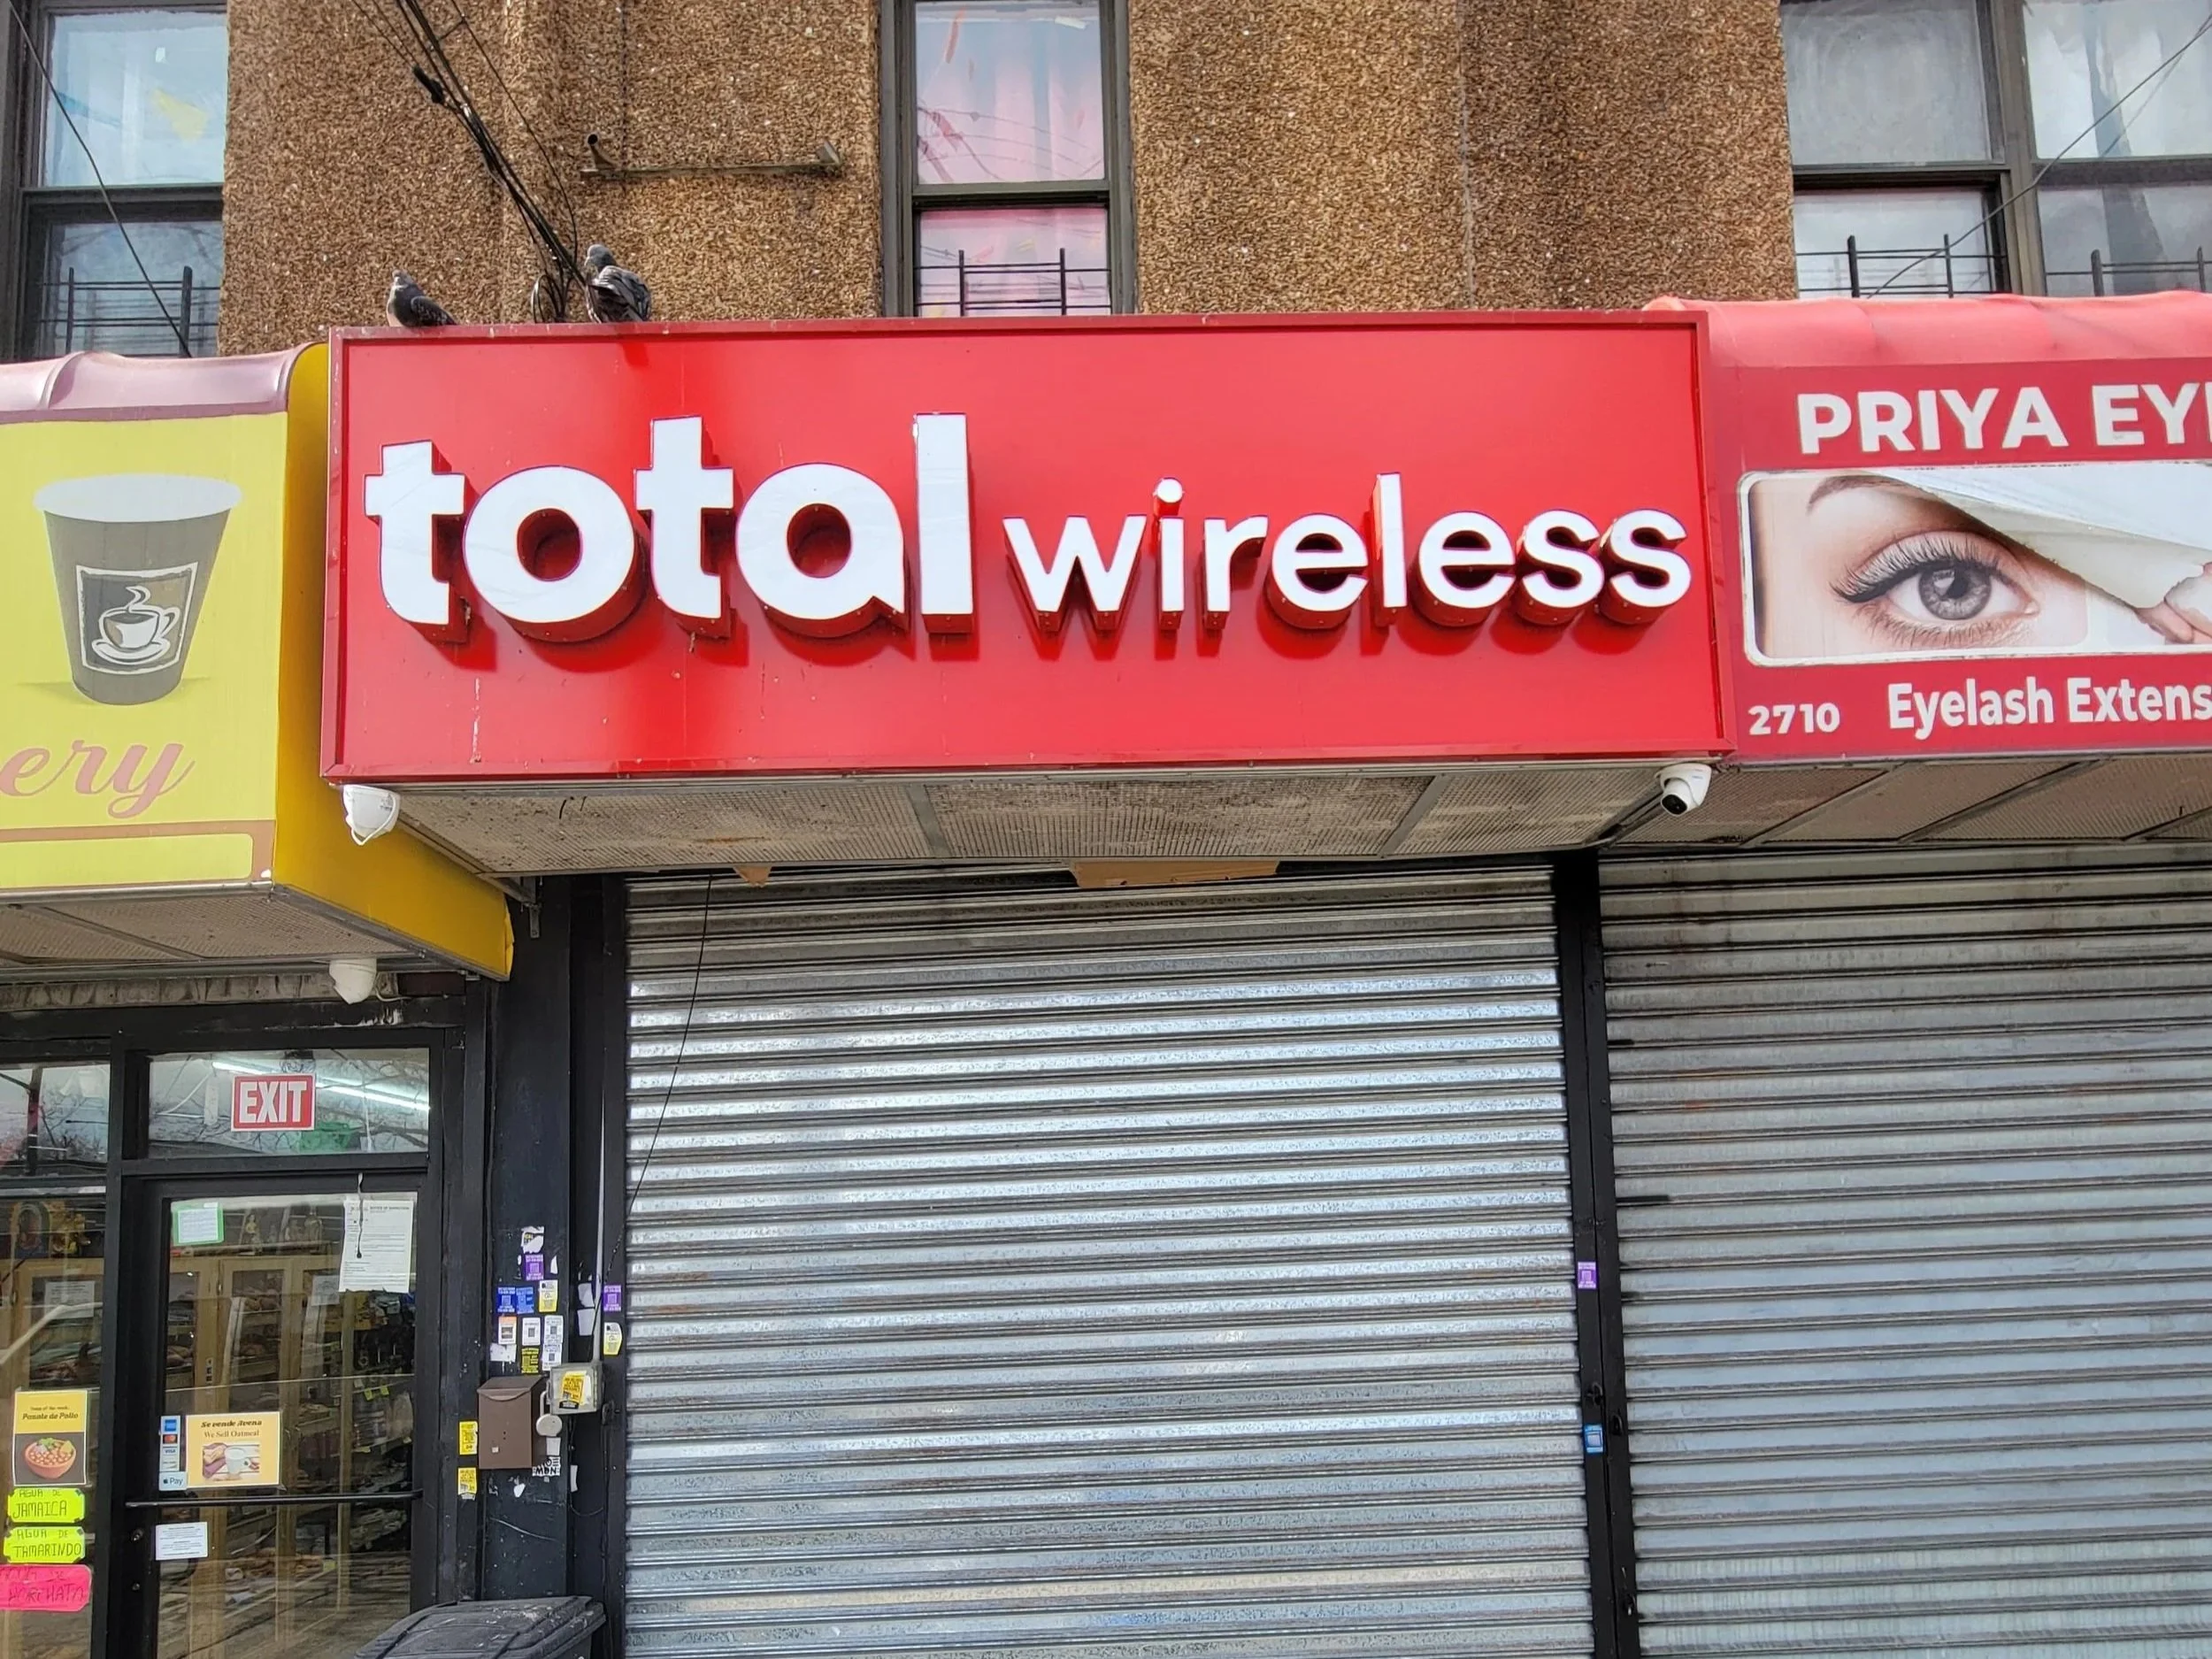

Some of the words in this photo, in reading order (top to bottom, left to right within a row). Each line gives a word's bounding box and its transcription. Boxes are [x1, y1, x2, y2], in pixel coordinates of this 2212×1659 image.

[1797, 387, 2069, 455] PRIYA
[2092, 381, 2212, 446] EY
[364, 412, 974, 626] total
[1002, 472, 1692, 613] wireless
[1748, 703, 1840, 735] 2710
[1887, 677, 2054, 740] Eyelash
[2067, 677, 2212, 723] Extens
[239, 1080, 308, 1124] EXIT
[169, 1477, 183, 1486] Pay
[19, 1489, 43, 1498] AGUA
[12, 1500, 67, 1518] JAMAICA
[17, 1529, 47, 1540] AGUA
[58, 1529, 68, 1539] DE
[12, 1542, 82, 1558] TAMARINDO
